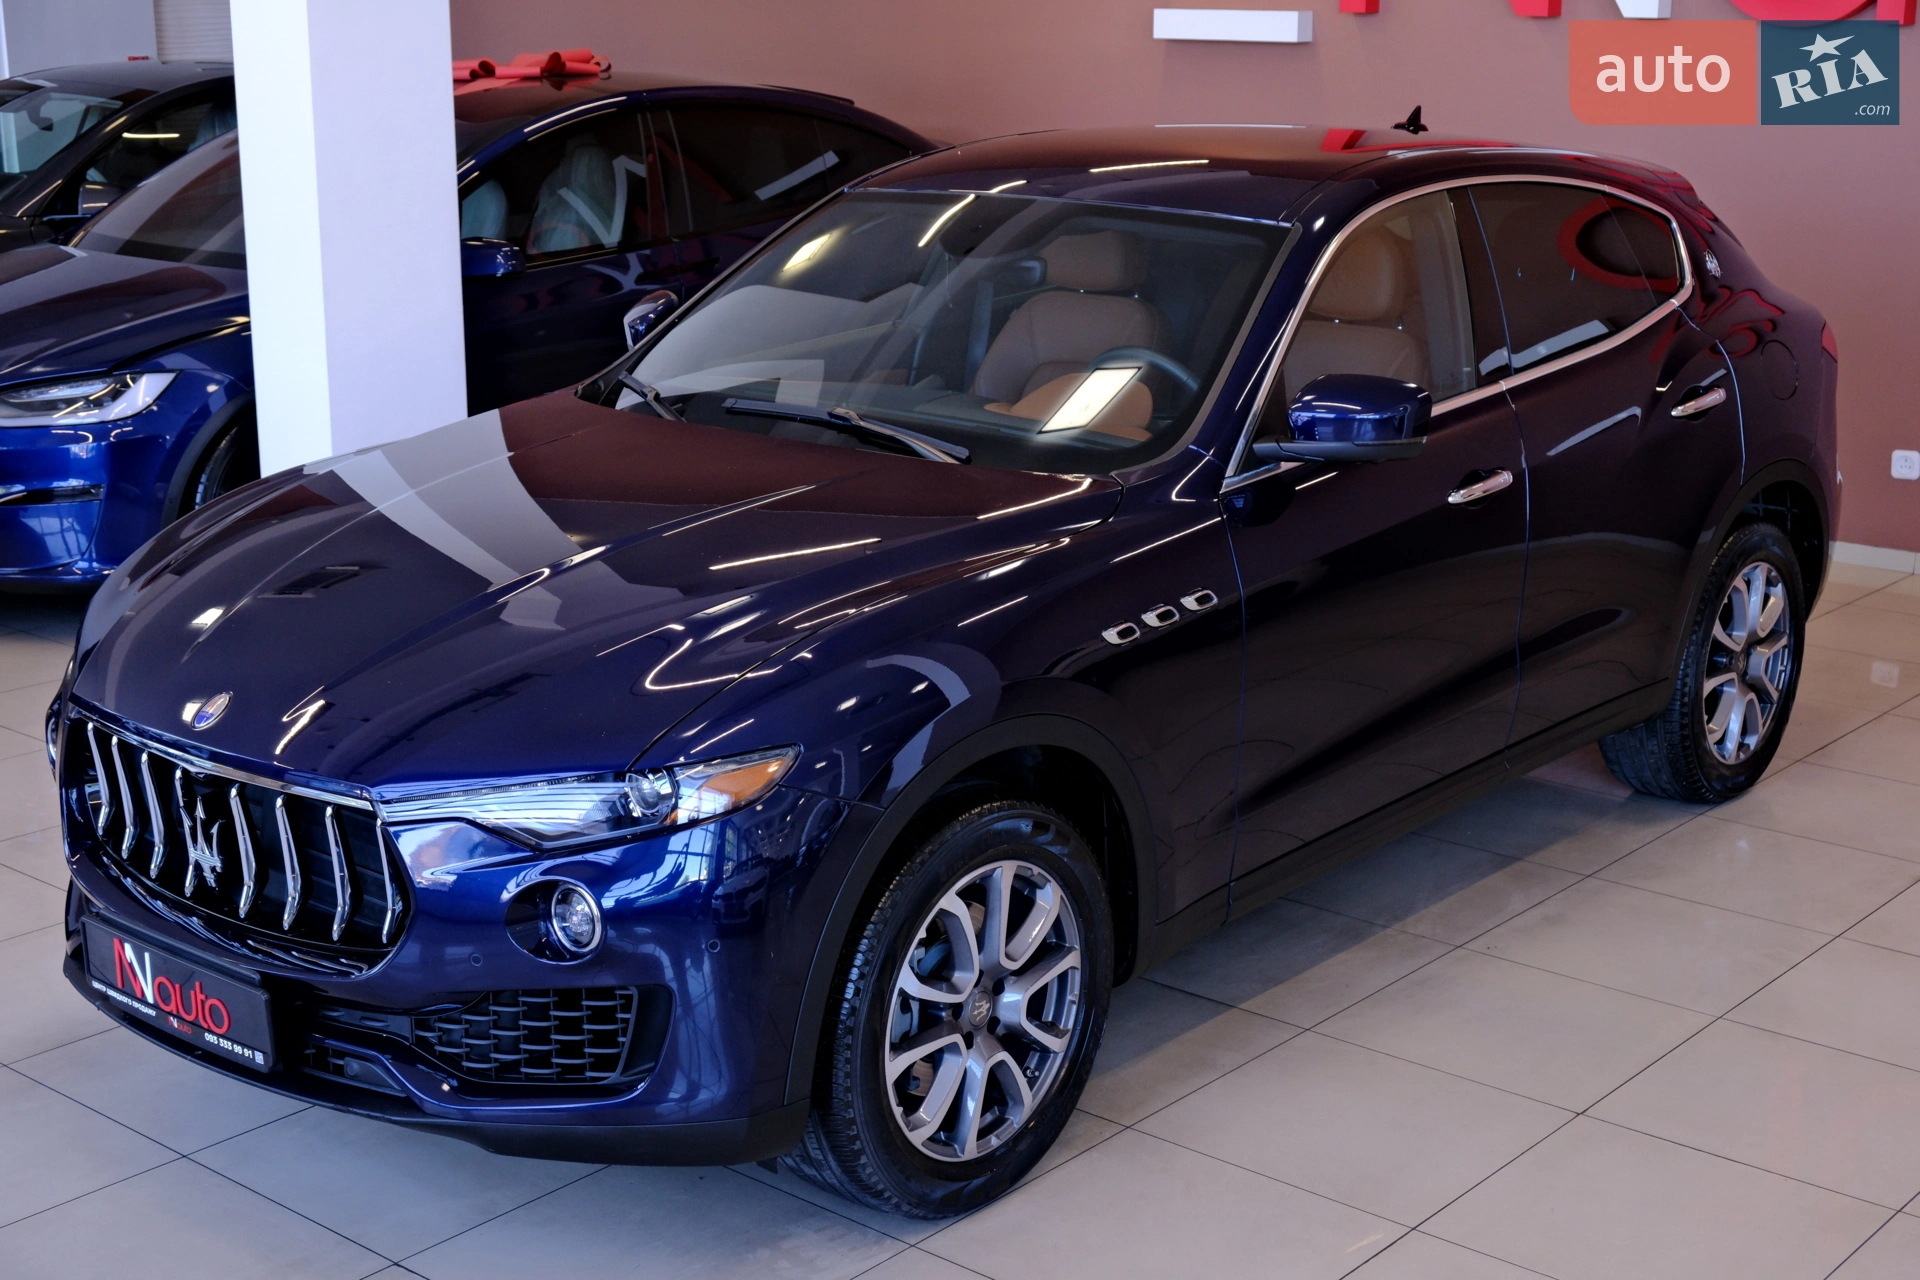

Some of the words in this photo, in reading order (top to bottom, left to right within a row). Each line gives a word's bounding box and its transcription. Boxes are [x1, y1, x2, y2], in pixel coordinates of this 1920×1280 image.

[204, 1032, 218, 1045] 093
[219, 1038, 233, 1051] 333
[233, 1044, 243, 1055] 99
[243, 1048, 253, 1059] 91
